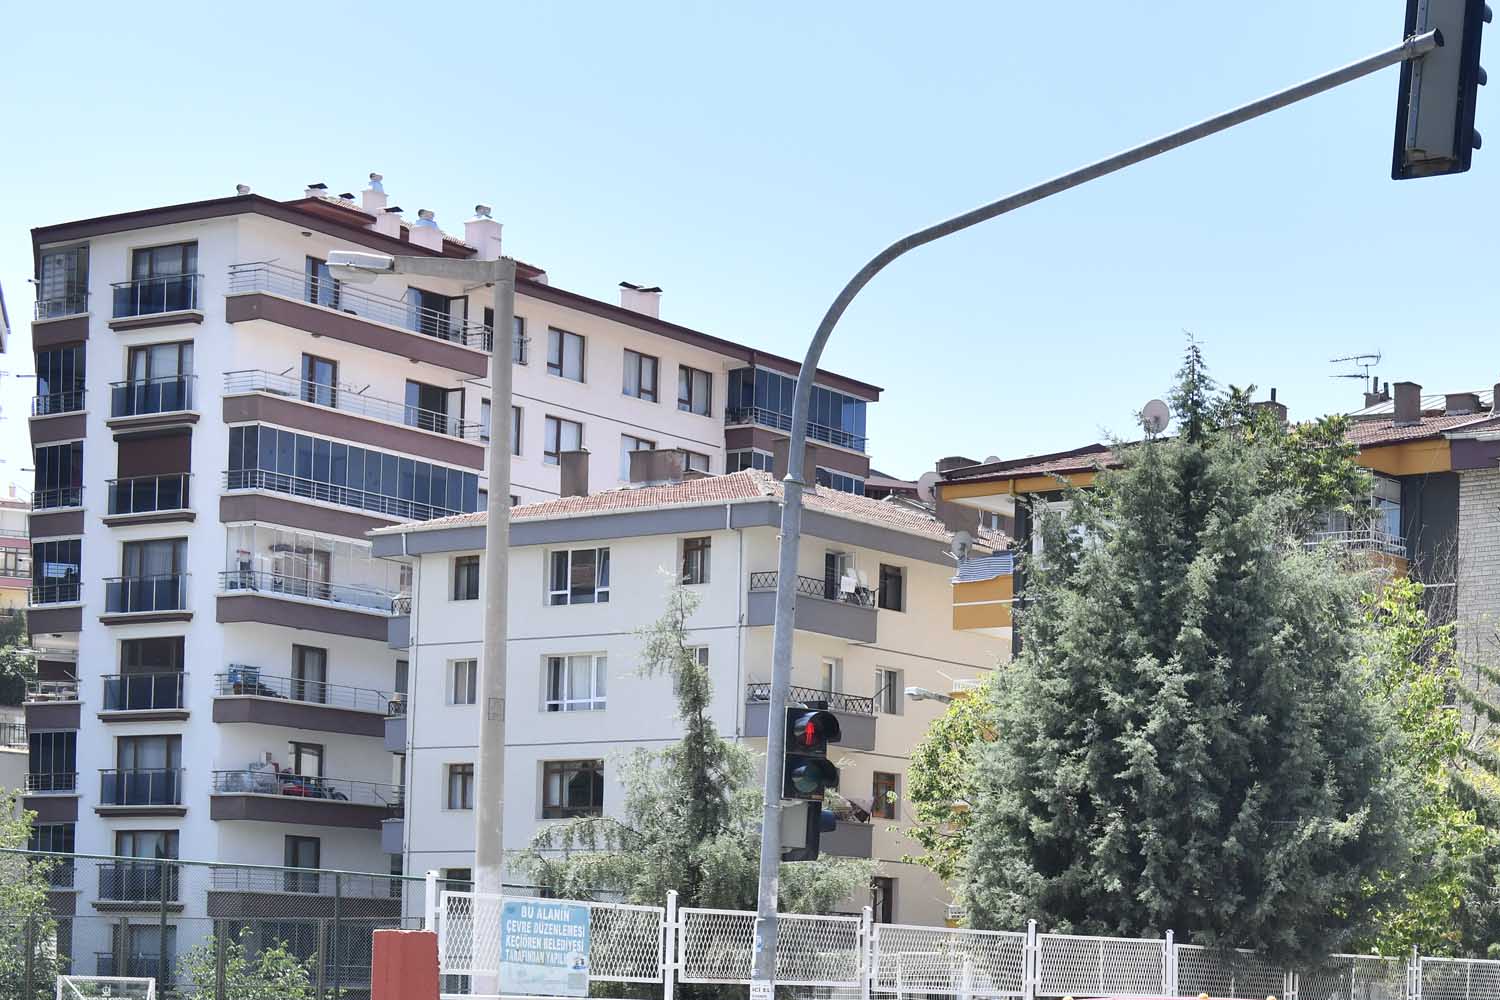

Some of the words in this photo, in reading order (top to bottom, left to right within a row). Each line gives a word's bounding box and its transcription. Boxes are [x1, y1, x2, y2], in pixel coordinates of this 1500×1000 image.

[521, 905, 534, 919] BU
[536, 907, 570, 922] ALANIN
[506, 919, 532, 933] ÇEVRE
[505, 933, 542, 949] KEÇİÖREN
[543, 937, 584, 952] BELEDİYESİ
